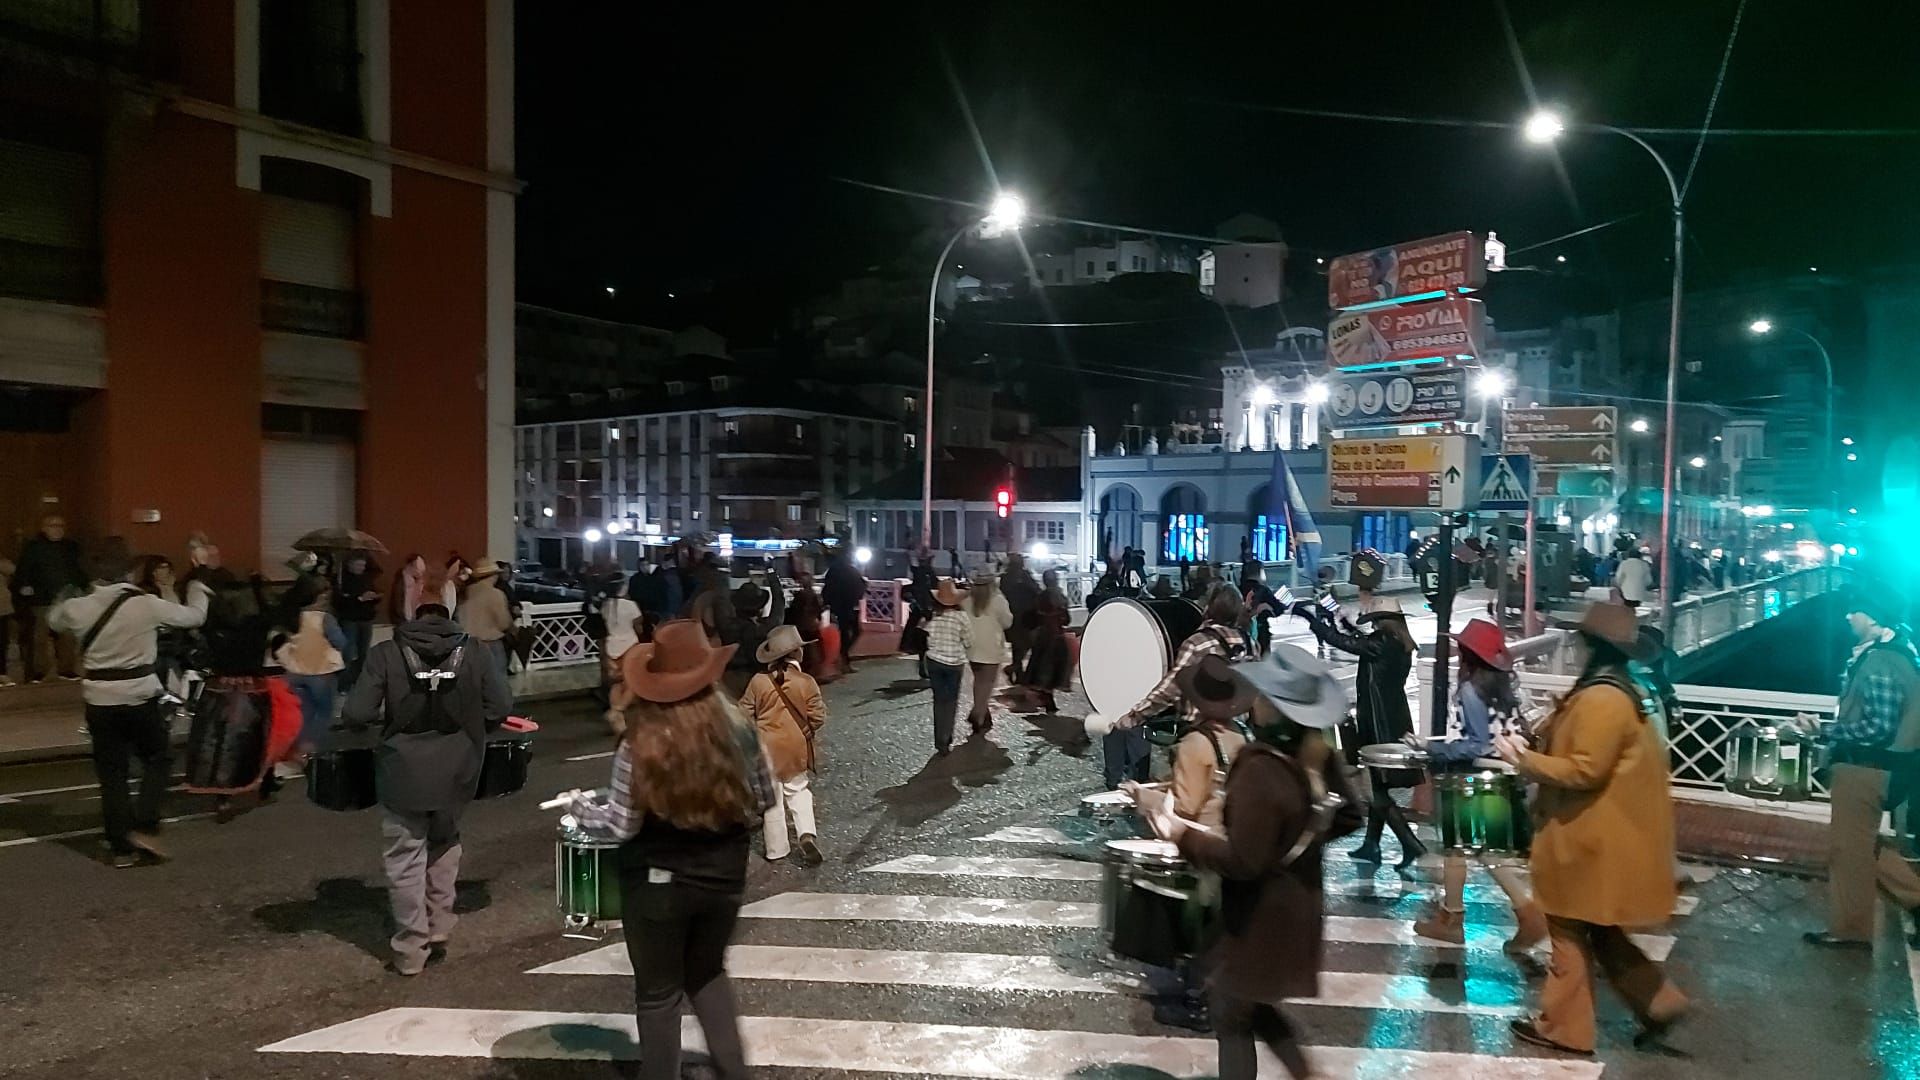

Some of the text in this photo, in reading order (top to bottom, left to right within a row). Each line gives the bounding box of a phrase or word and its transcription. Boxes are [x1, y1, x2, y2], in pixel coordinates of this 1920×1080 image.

[1332, 318, 1361, 340] LONAS
[1332, 443, 1408, 456] Oficina de Turismo
[1332, 459, 1406, 471] Casa de la Cultura
[1361, 475, 1373, 487] de
[1332, 489, 1359, 504] Playas
